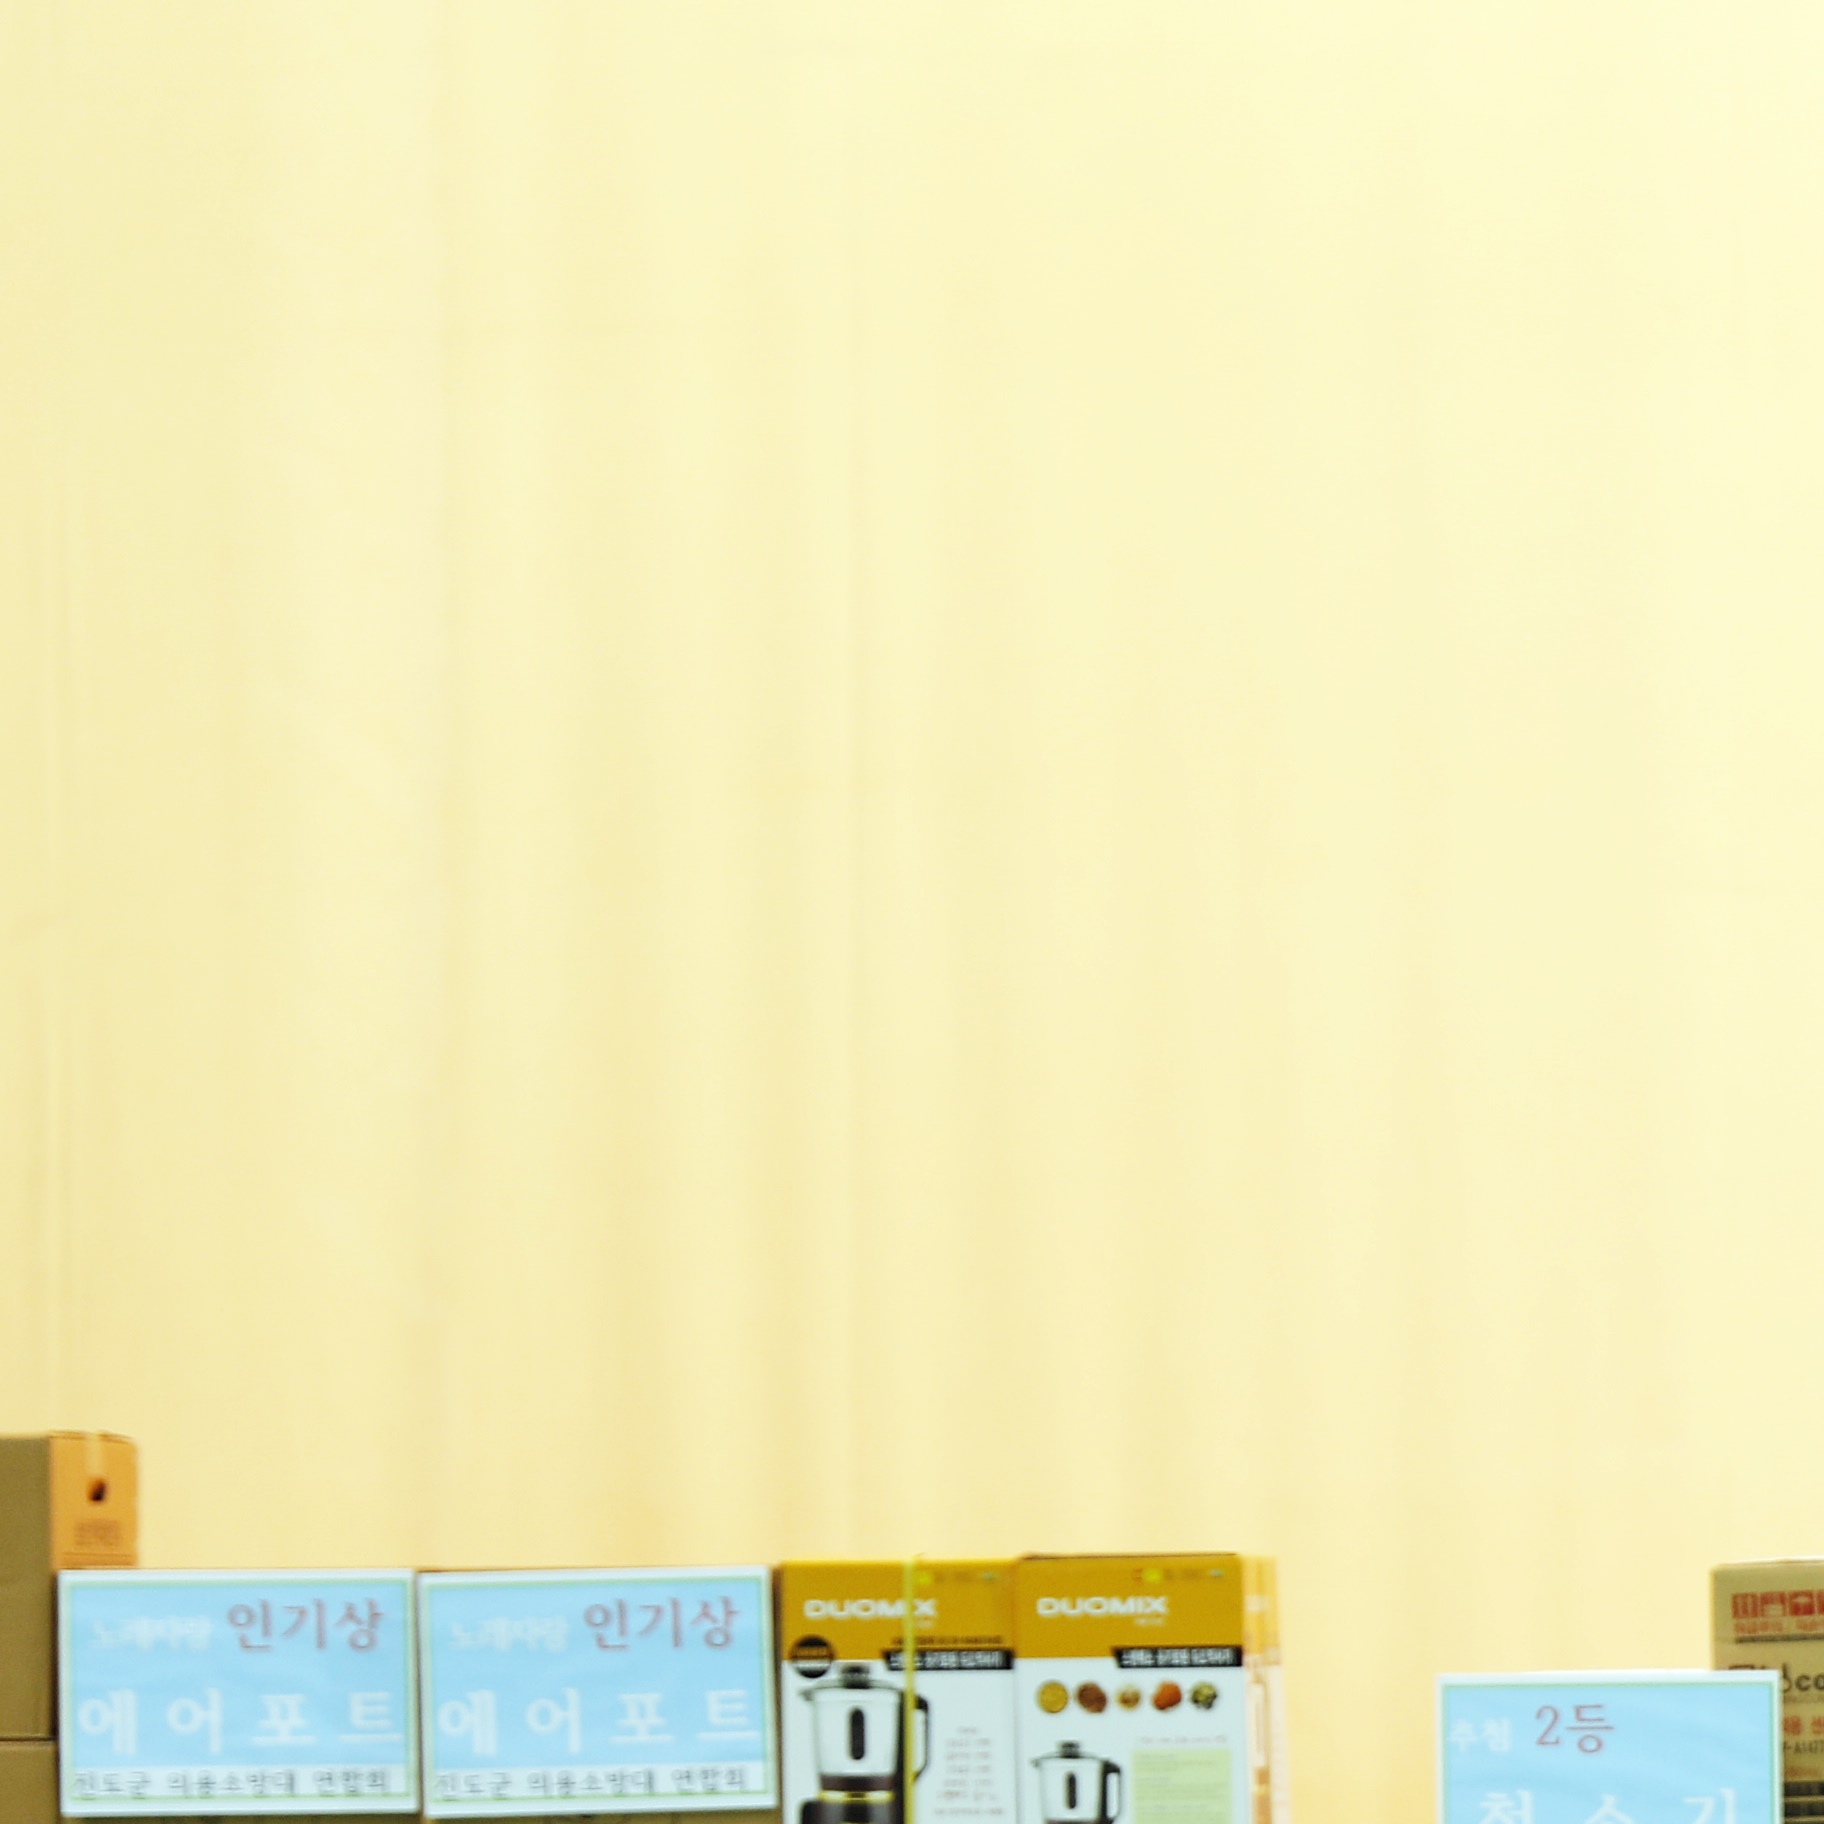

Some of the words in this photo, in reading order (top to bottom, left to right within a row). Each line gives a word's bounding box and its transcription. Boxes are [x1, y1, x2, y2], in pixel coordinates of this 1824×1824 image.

[227, 1598, 384, 1653] 인기상
[583, 1596, 740, 1652] 인기상
[803, 1598, 938, 1620] DUOMX
[1036, 1596, 1168, 1618] DUOMIX
[77, 1688, 402, 1756] 에어포트
[438, 1687, 761, 1756] 에어포트
[1535, 1703, 1615, 1754] 2등
[75, 1770, 151, 1799] 진도군
[167, 1769, 295, 1798] 의용소방대
[313, 1769, 387, 1796] 연합회
[435, 1771, 512, 1801] 진도군
[527, 1768, 654, 1798] 의용소방대
[670, 1767, 746, 1795] 연합회
